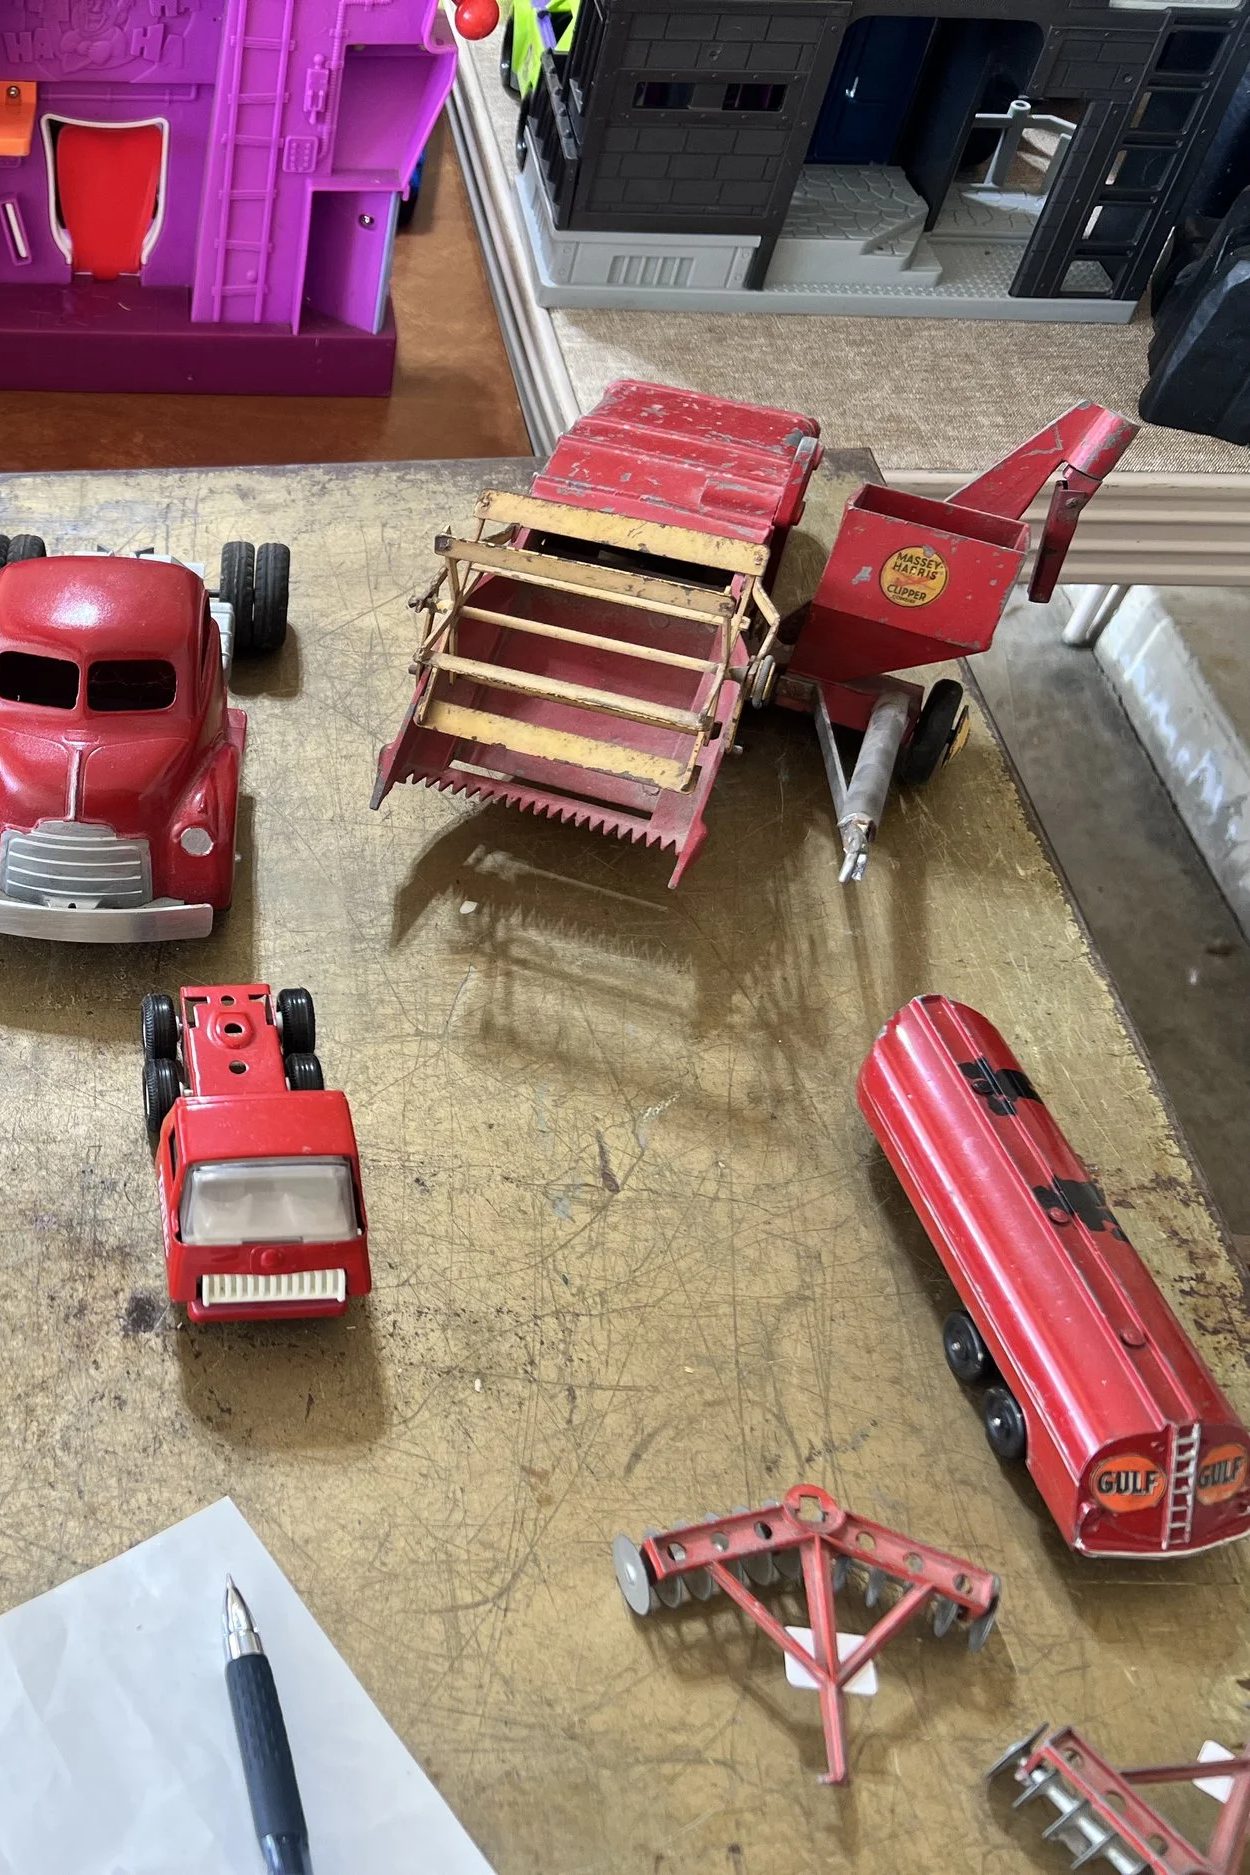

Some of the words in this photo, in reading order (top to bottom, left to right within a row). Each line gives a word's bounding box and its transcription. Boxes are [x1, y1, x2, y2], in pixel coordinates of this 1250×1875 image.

[887, 584, 927, 601] CLIPPER
[1099, 1470, 1160, 1496] GULF
[1199, 1456, 1244, 1490] GULF
